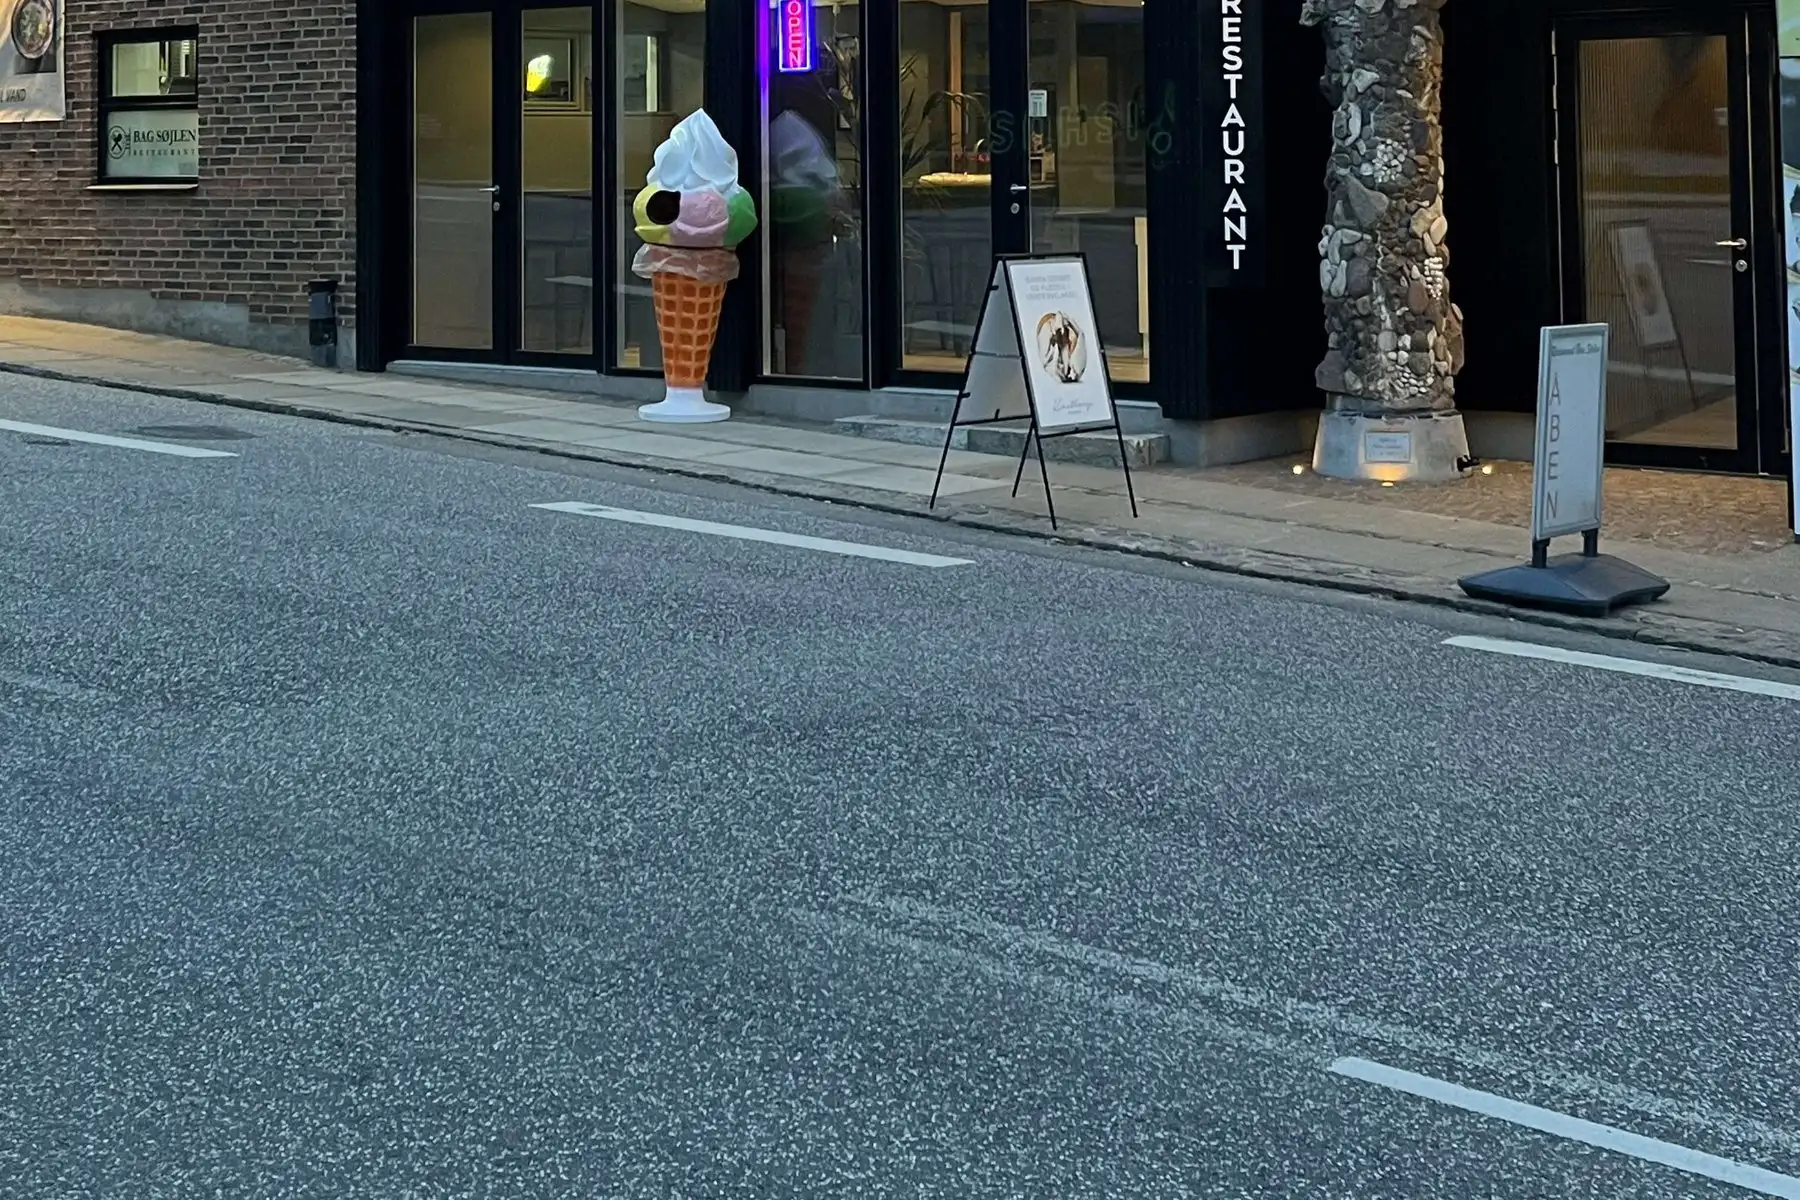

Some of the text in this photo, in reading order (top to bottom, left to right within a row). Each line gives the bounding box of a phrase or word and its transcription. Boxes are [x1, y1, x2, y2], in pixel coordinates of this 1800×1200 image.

[787, 0, 803, 68] OPEN
[133, 129, 197, 146] BAG SØJLEN
